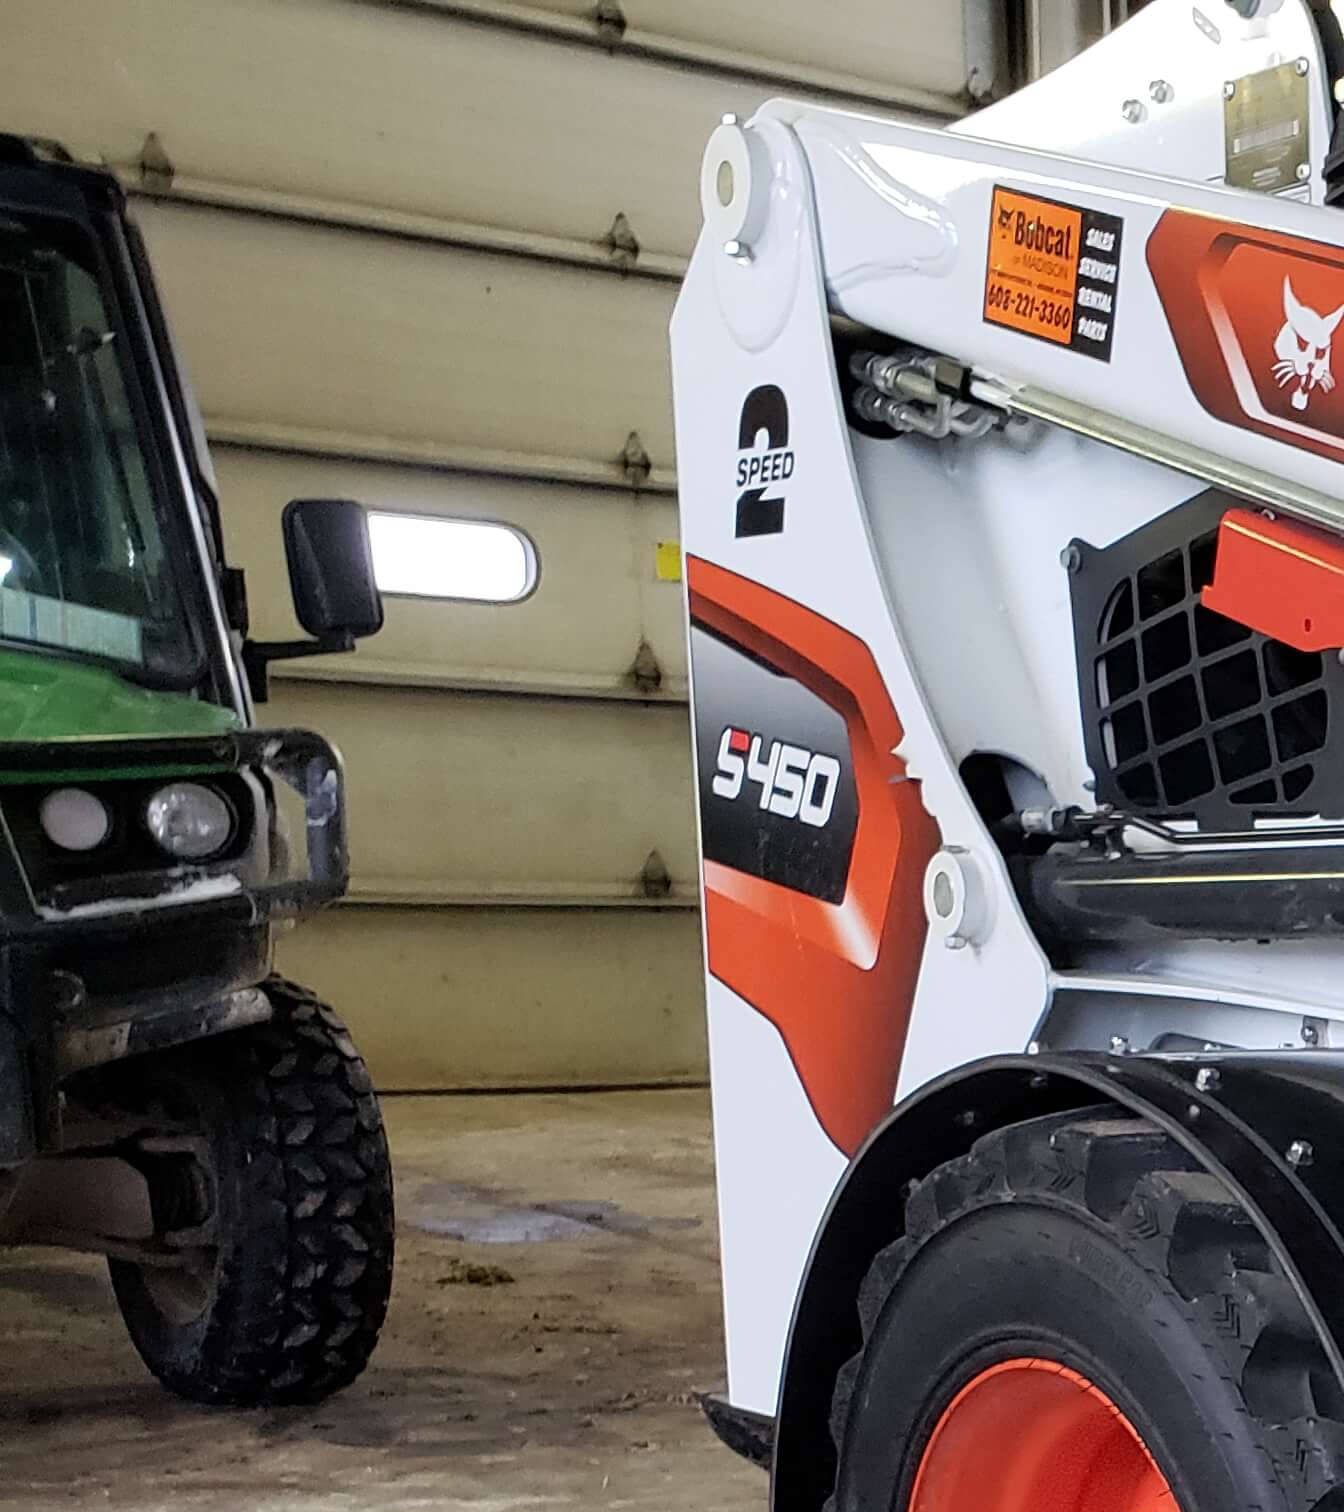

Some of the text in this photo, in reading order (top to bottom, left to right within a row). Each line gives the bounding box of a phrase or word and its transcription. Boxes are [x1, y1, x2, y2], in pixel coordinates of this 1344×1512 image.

[1014, 211, 1072, 260] Bobcat
[988, 283, 1071, 330] 608-221-3360
[736, 452, 794, 487] SPEED
[712, 727, 841, 828] S450
